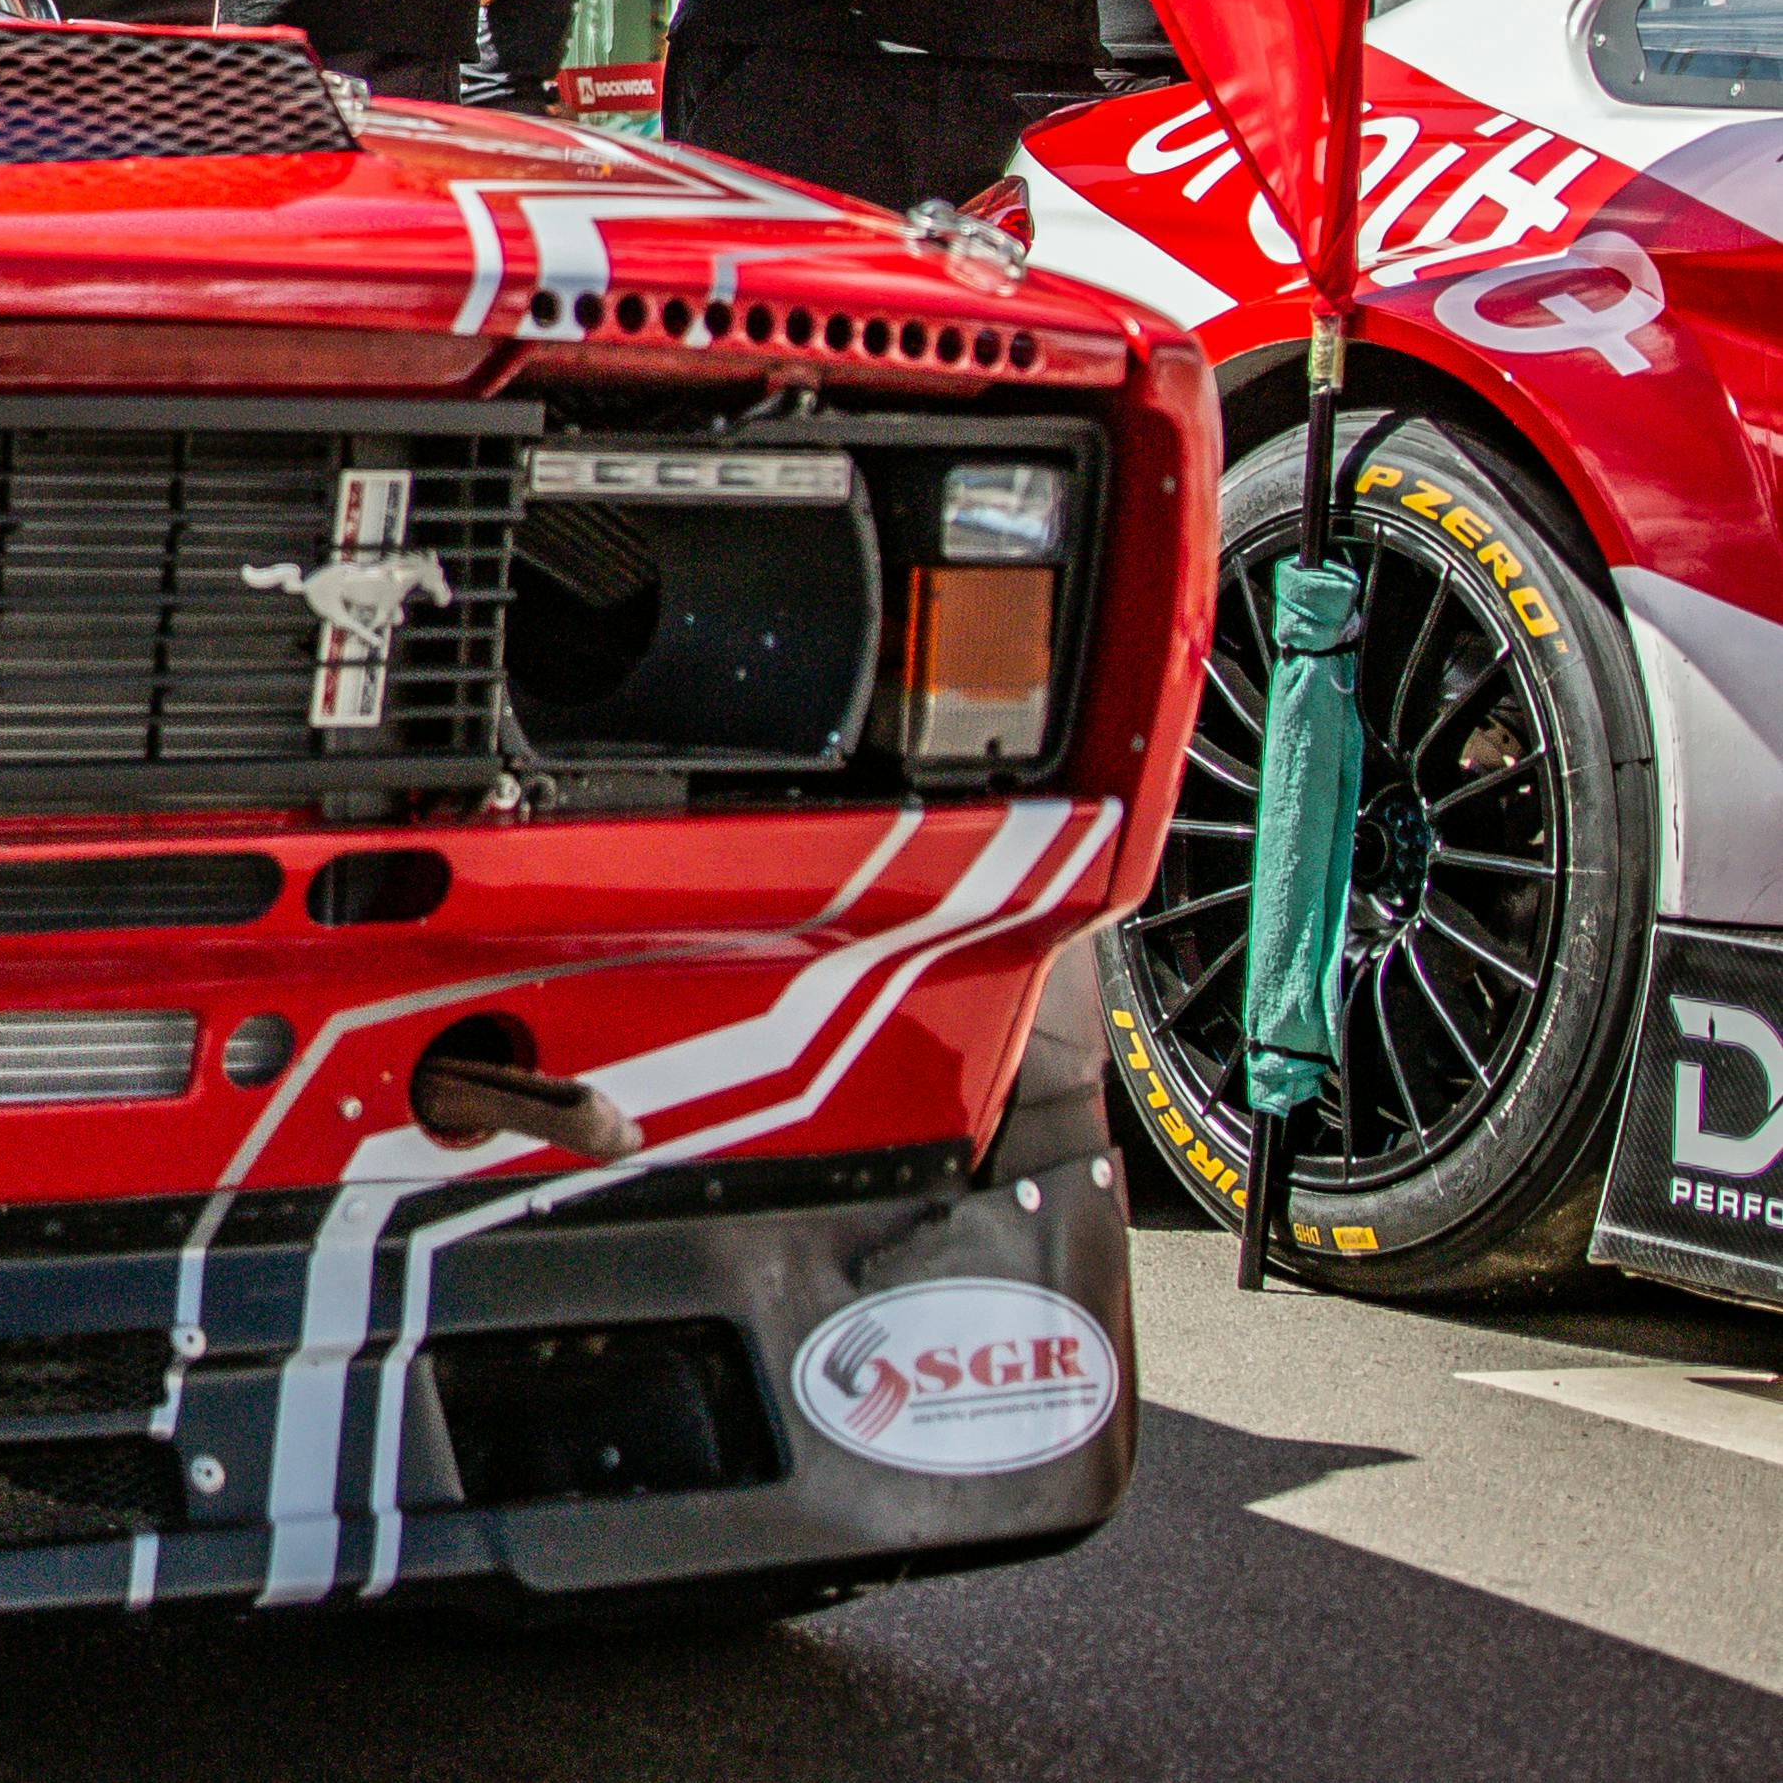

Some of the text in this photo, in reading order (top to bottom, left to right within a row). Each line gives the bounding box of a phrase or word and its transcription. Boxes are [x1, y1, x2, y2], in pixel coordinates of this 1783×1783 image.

[596, 78, 656, 98] ROCKWOOL
[1354, 464, 1561, 638] P ZERO
[914, 1335, 1088, 1394] SGR
